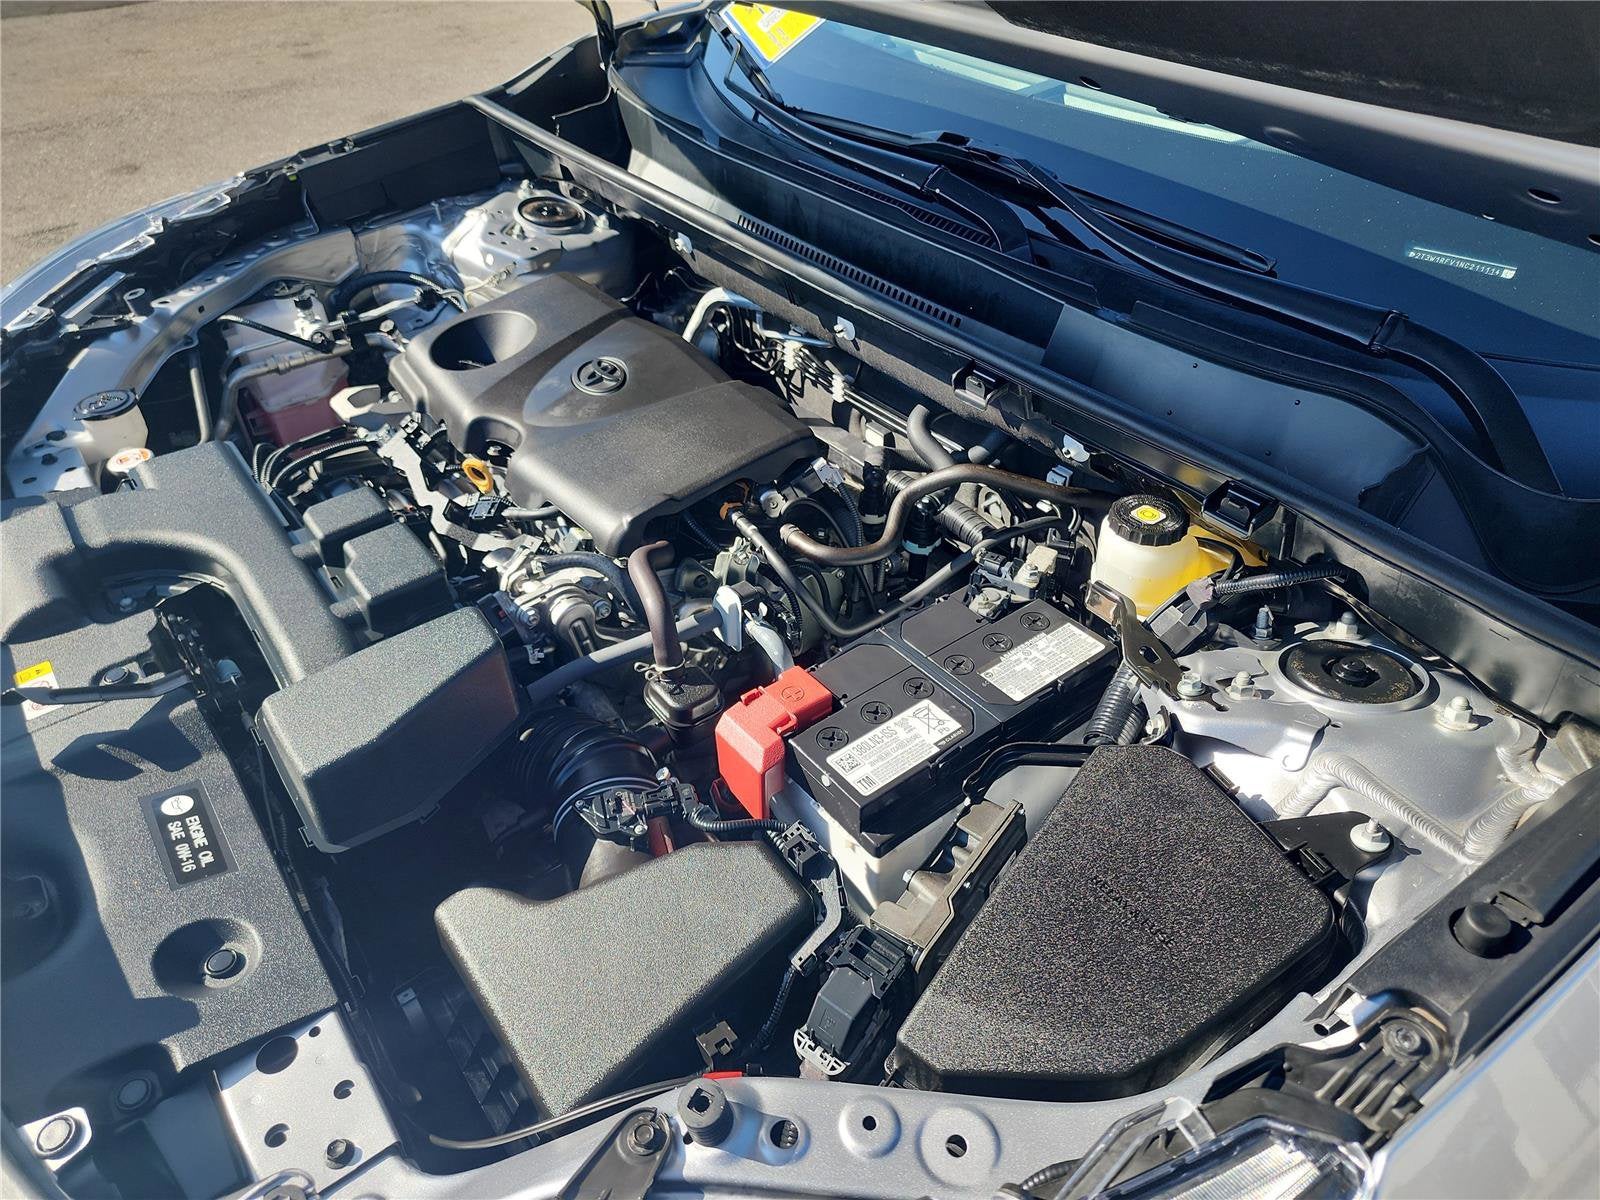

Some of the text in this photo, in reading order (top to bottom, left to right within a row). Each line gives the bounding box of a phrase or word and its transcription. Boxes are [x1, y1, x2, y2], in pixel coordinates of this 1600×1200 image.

[1415, 252, 1500, 276] 2T3W1RFV1NC211114
[852, 726, 898, 757] 380LN3-ISS
[857, 775, 876, 790] TM
[167, 820, 197, 873] SAE 0W-16
[185, 815, 215, 868] ENGINE OIL
